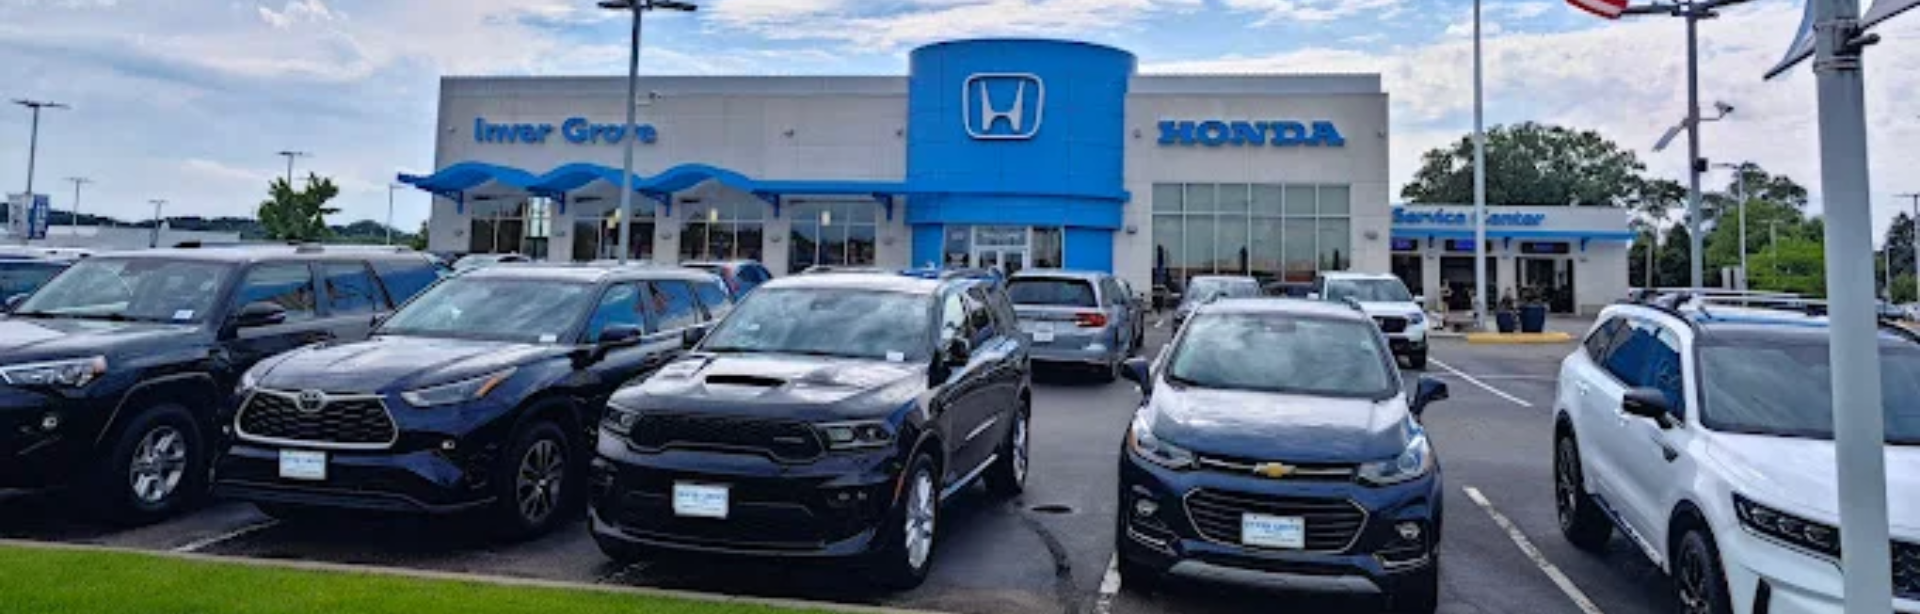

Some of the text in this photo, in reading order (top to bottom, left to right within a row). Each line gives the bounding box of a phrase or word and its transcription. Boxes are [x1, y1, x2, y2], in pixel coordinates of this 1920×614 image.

[474, 116, 657, 144] Inver Groe
[1157, 120, 1345, 147] HONDA
